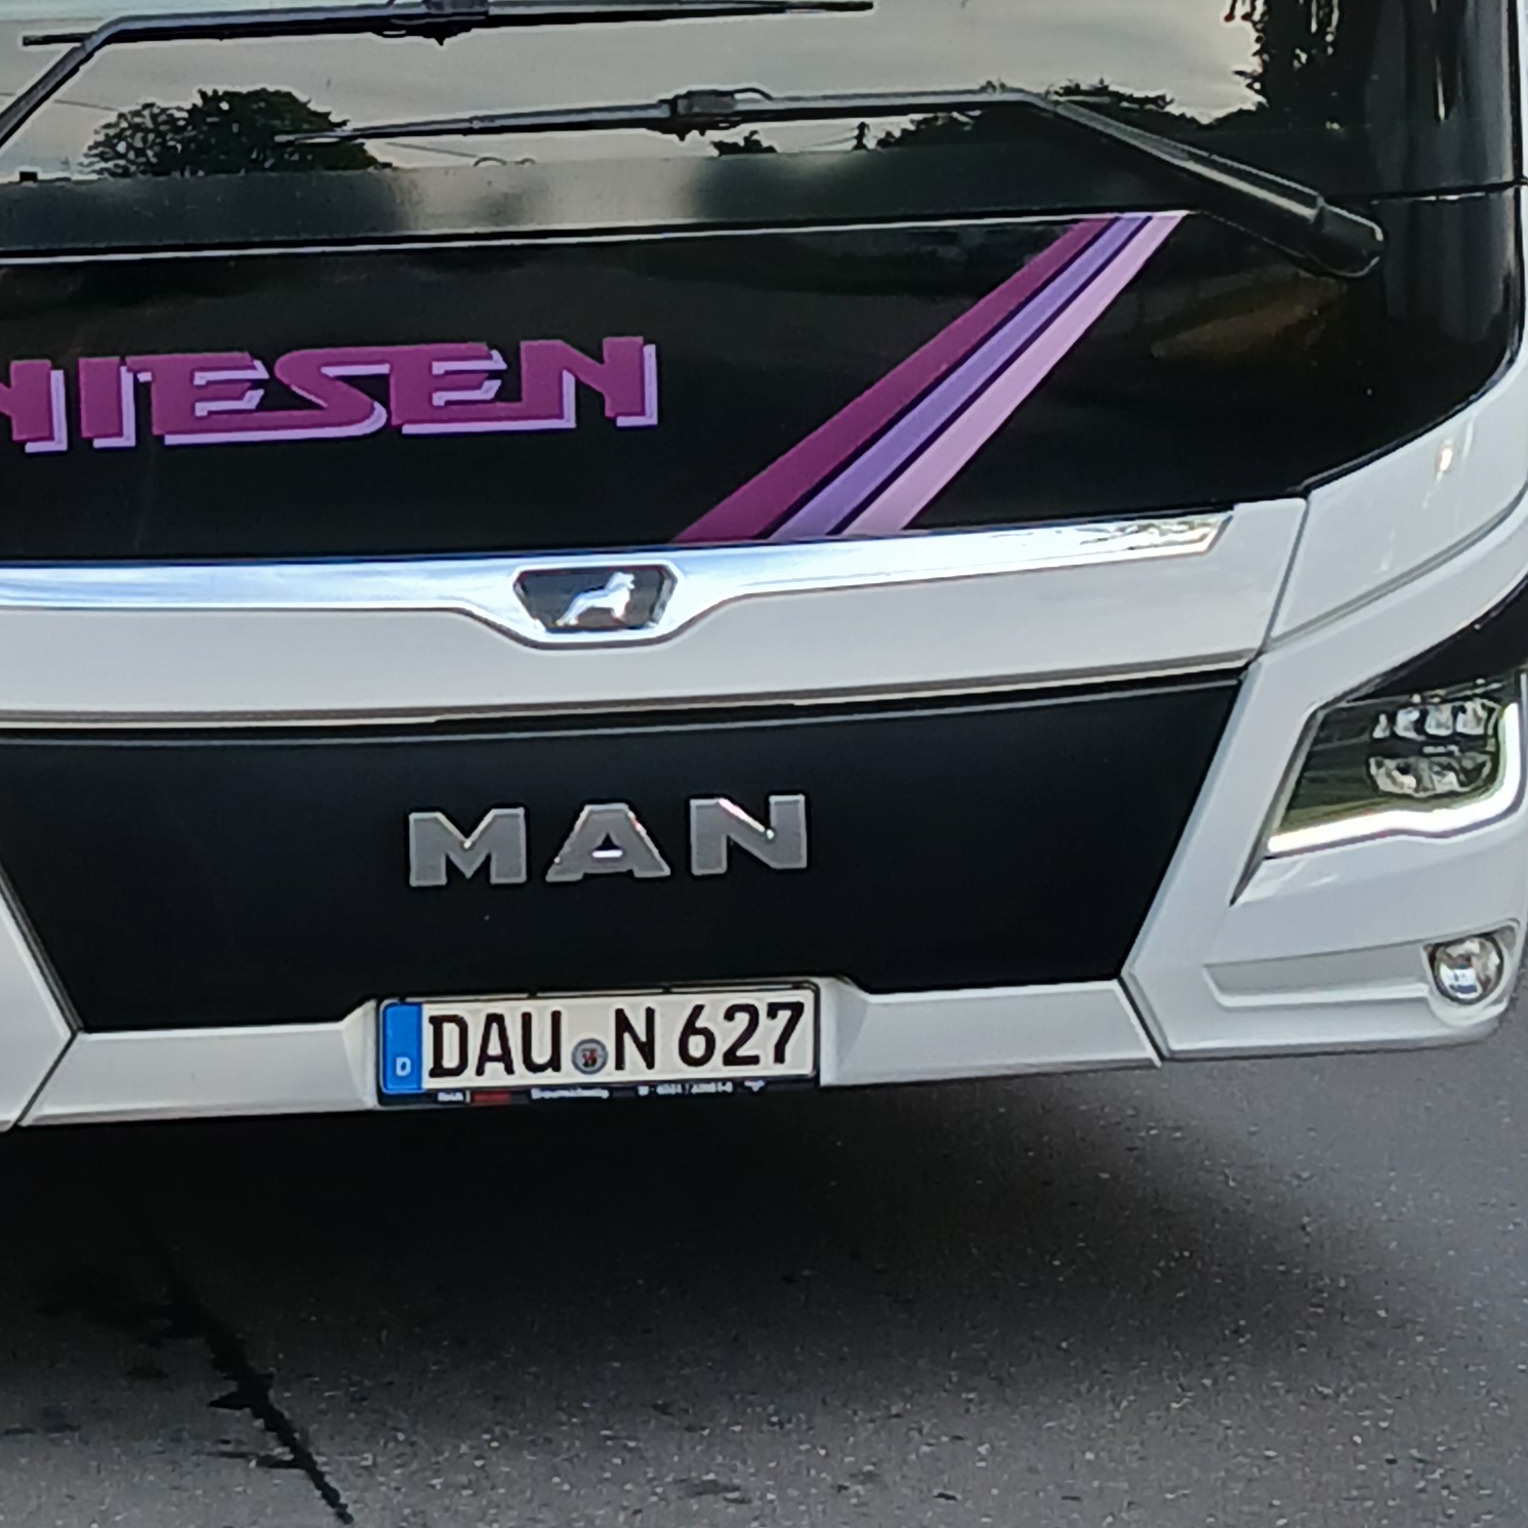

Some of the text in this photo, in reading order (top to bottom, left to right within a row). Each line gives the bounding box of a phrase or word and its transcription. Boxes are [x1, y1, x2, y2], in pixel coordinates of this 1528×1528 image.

[408, 794, 808, 886] MAN
[395, 1057, 412, 1077] D
[428, 1000, 805, 1078] DAU N 627
